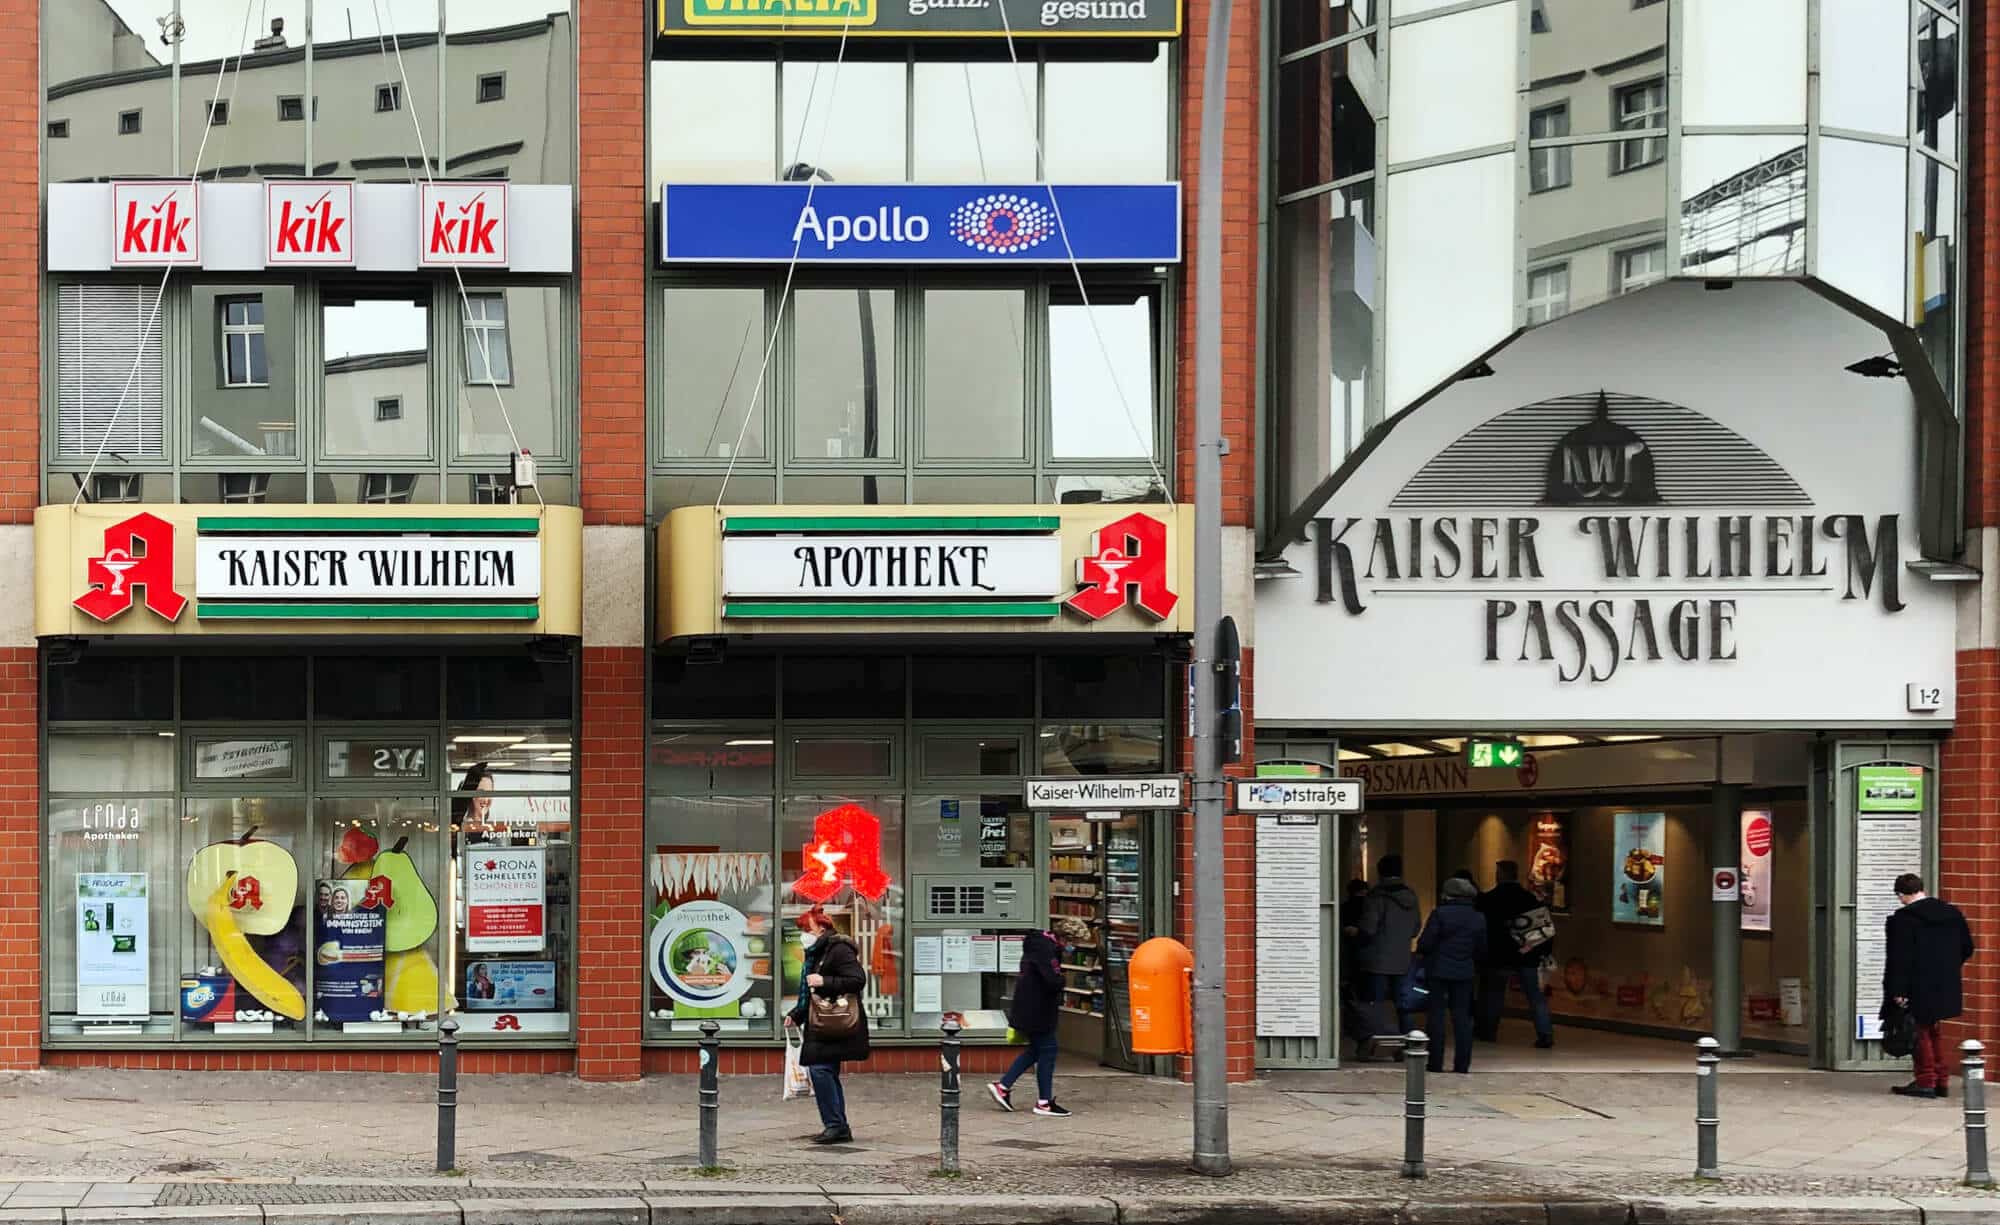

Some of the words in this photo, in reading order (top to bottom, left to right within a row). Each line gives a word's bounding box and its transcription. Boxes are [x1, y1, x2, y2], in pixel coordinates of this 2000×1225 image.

[1040, 0, 1146, 25] gesund
[122, 191, 192, 252] kik
[277, 191, 345, 252] kik
[430, 191, 499, 253] kik
[792, 205, 930, 250] Apollo
[218, 549, 348, 587] KAISER
[358, 549, 515, 587] WILHELM
[794, 545, 996, 592] APOTHEKE
[1302, 514, 1543, 616] KAISER
[1579, 513, 1905, 612] WILHELM
[1485, 599, 1738, 683] PASSAGE
[1920, 688, 1940, 705] 1-2
[1032, 783, 1176, 800] Kaiser-Wilhelm-Platz
[1249, 785, 1347, 806] Hptstraße
[84, 832, 139, 842] Apotheken
[474, 873, 537, 881] SCHNELLTEST
